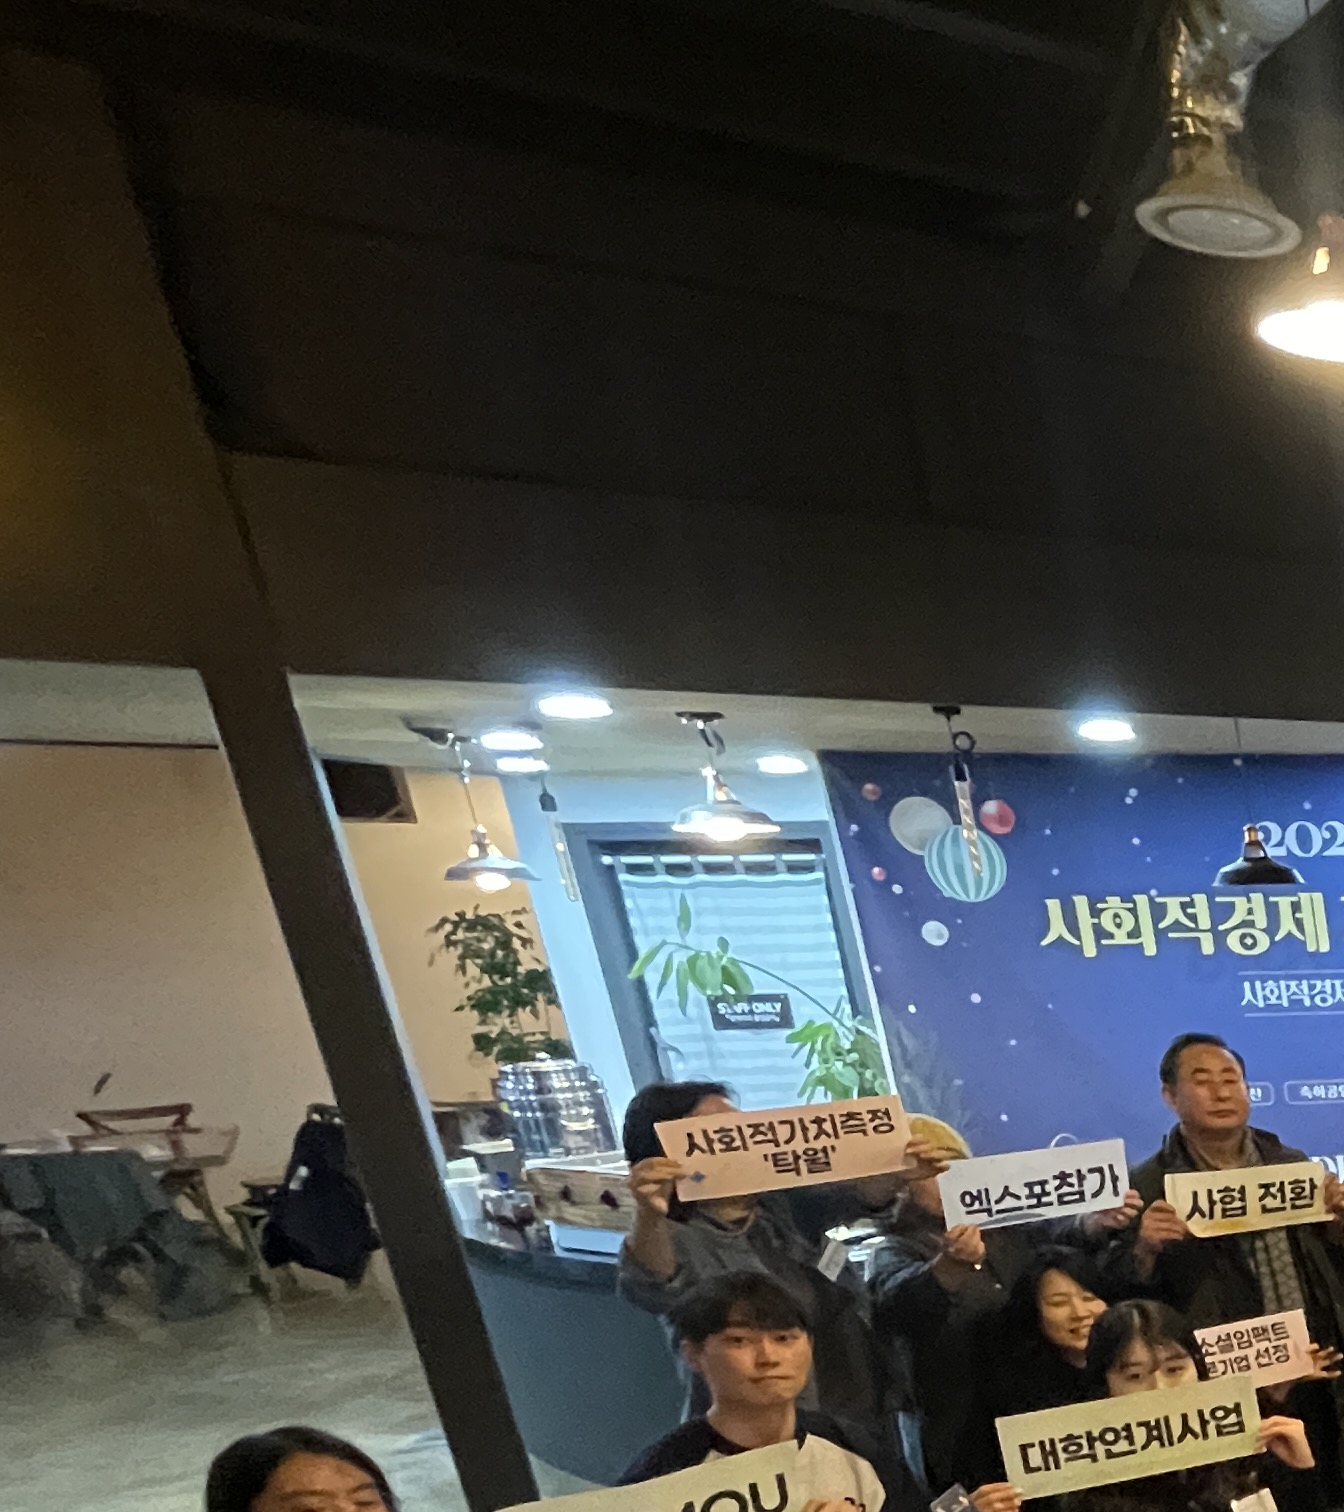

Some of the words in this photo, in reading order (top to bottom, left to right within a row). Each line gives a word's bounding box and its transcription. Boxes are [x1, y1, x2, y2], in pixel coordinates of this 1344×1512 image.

[1039, 892, 1331, 958] 사회적경제
[685, 1106, 896, 1157] 사회적가치측정
[763, 1145, 838, 1177] '탁월'
[958, 1163, 1121, 1219] 엑스포참가
[1185, 1184, 1248, 1223] 사협
[1256, 1176, 1319, 1215] 전환
[1200, 1320, 1290, 1357] 소셜임팩트
[1254, 1342, 1291, 1369] 선정
[1018, 1402, 1247, 1475] 대학연계사업
